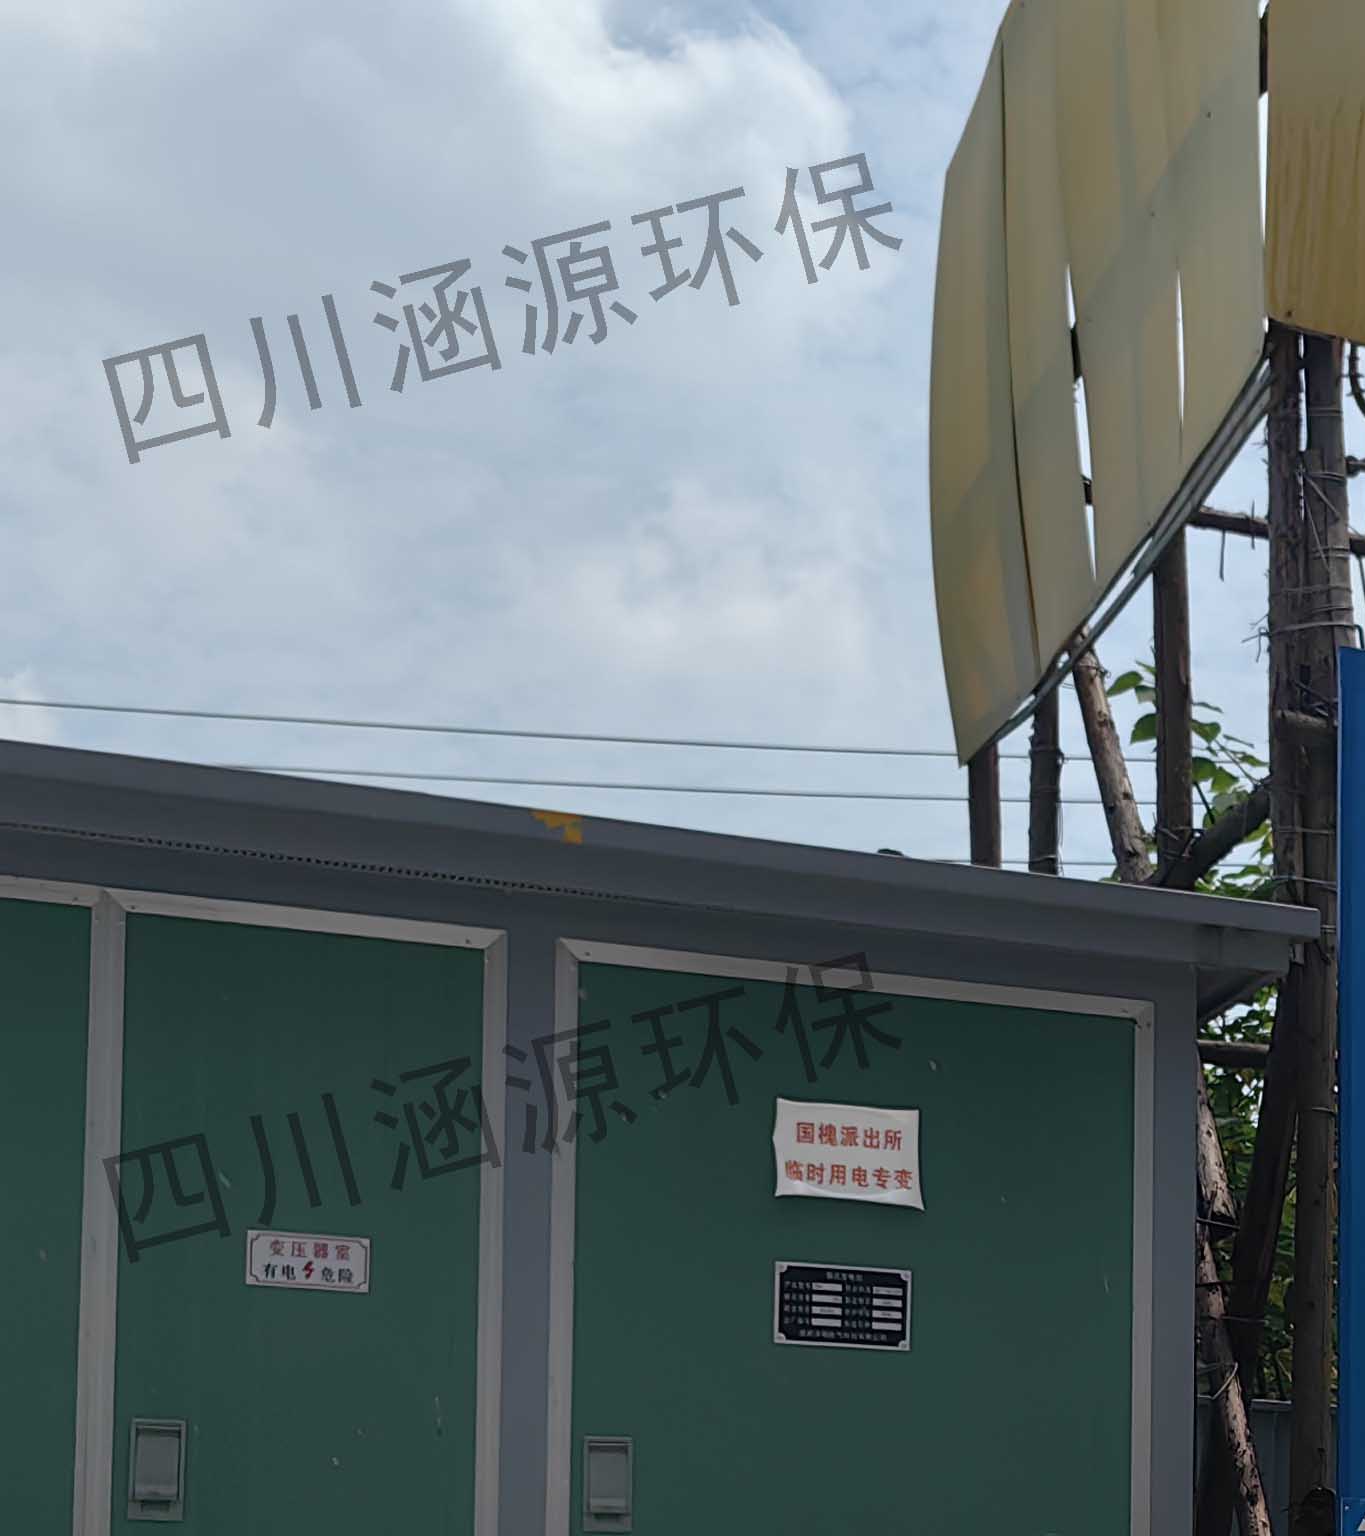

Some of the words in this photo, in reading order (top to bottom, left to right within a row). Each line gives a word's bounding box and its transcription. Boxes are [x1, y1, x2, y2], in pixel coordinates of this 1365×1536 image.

[795, 1121, 903, 1151] 国槐派出所
[784, 1159, 913, 1191] 临时用电专变
[264, 1263, 296, 1280] 有电
[321, 1265, 353, 1283] 危险
